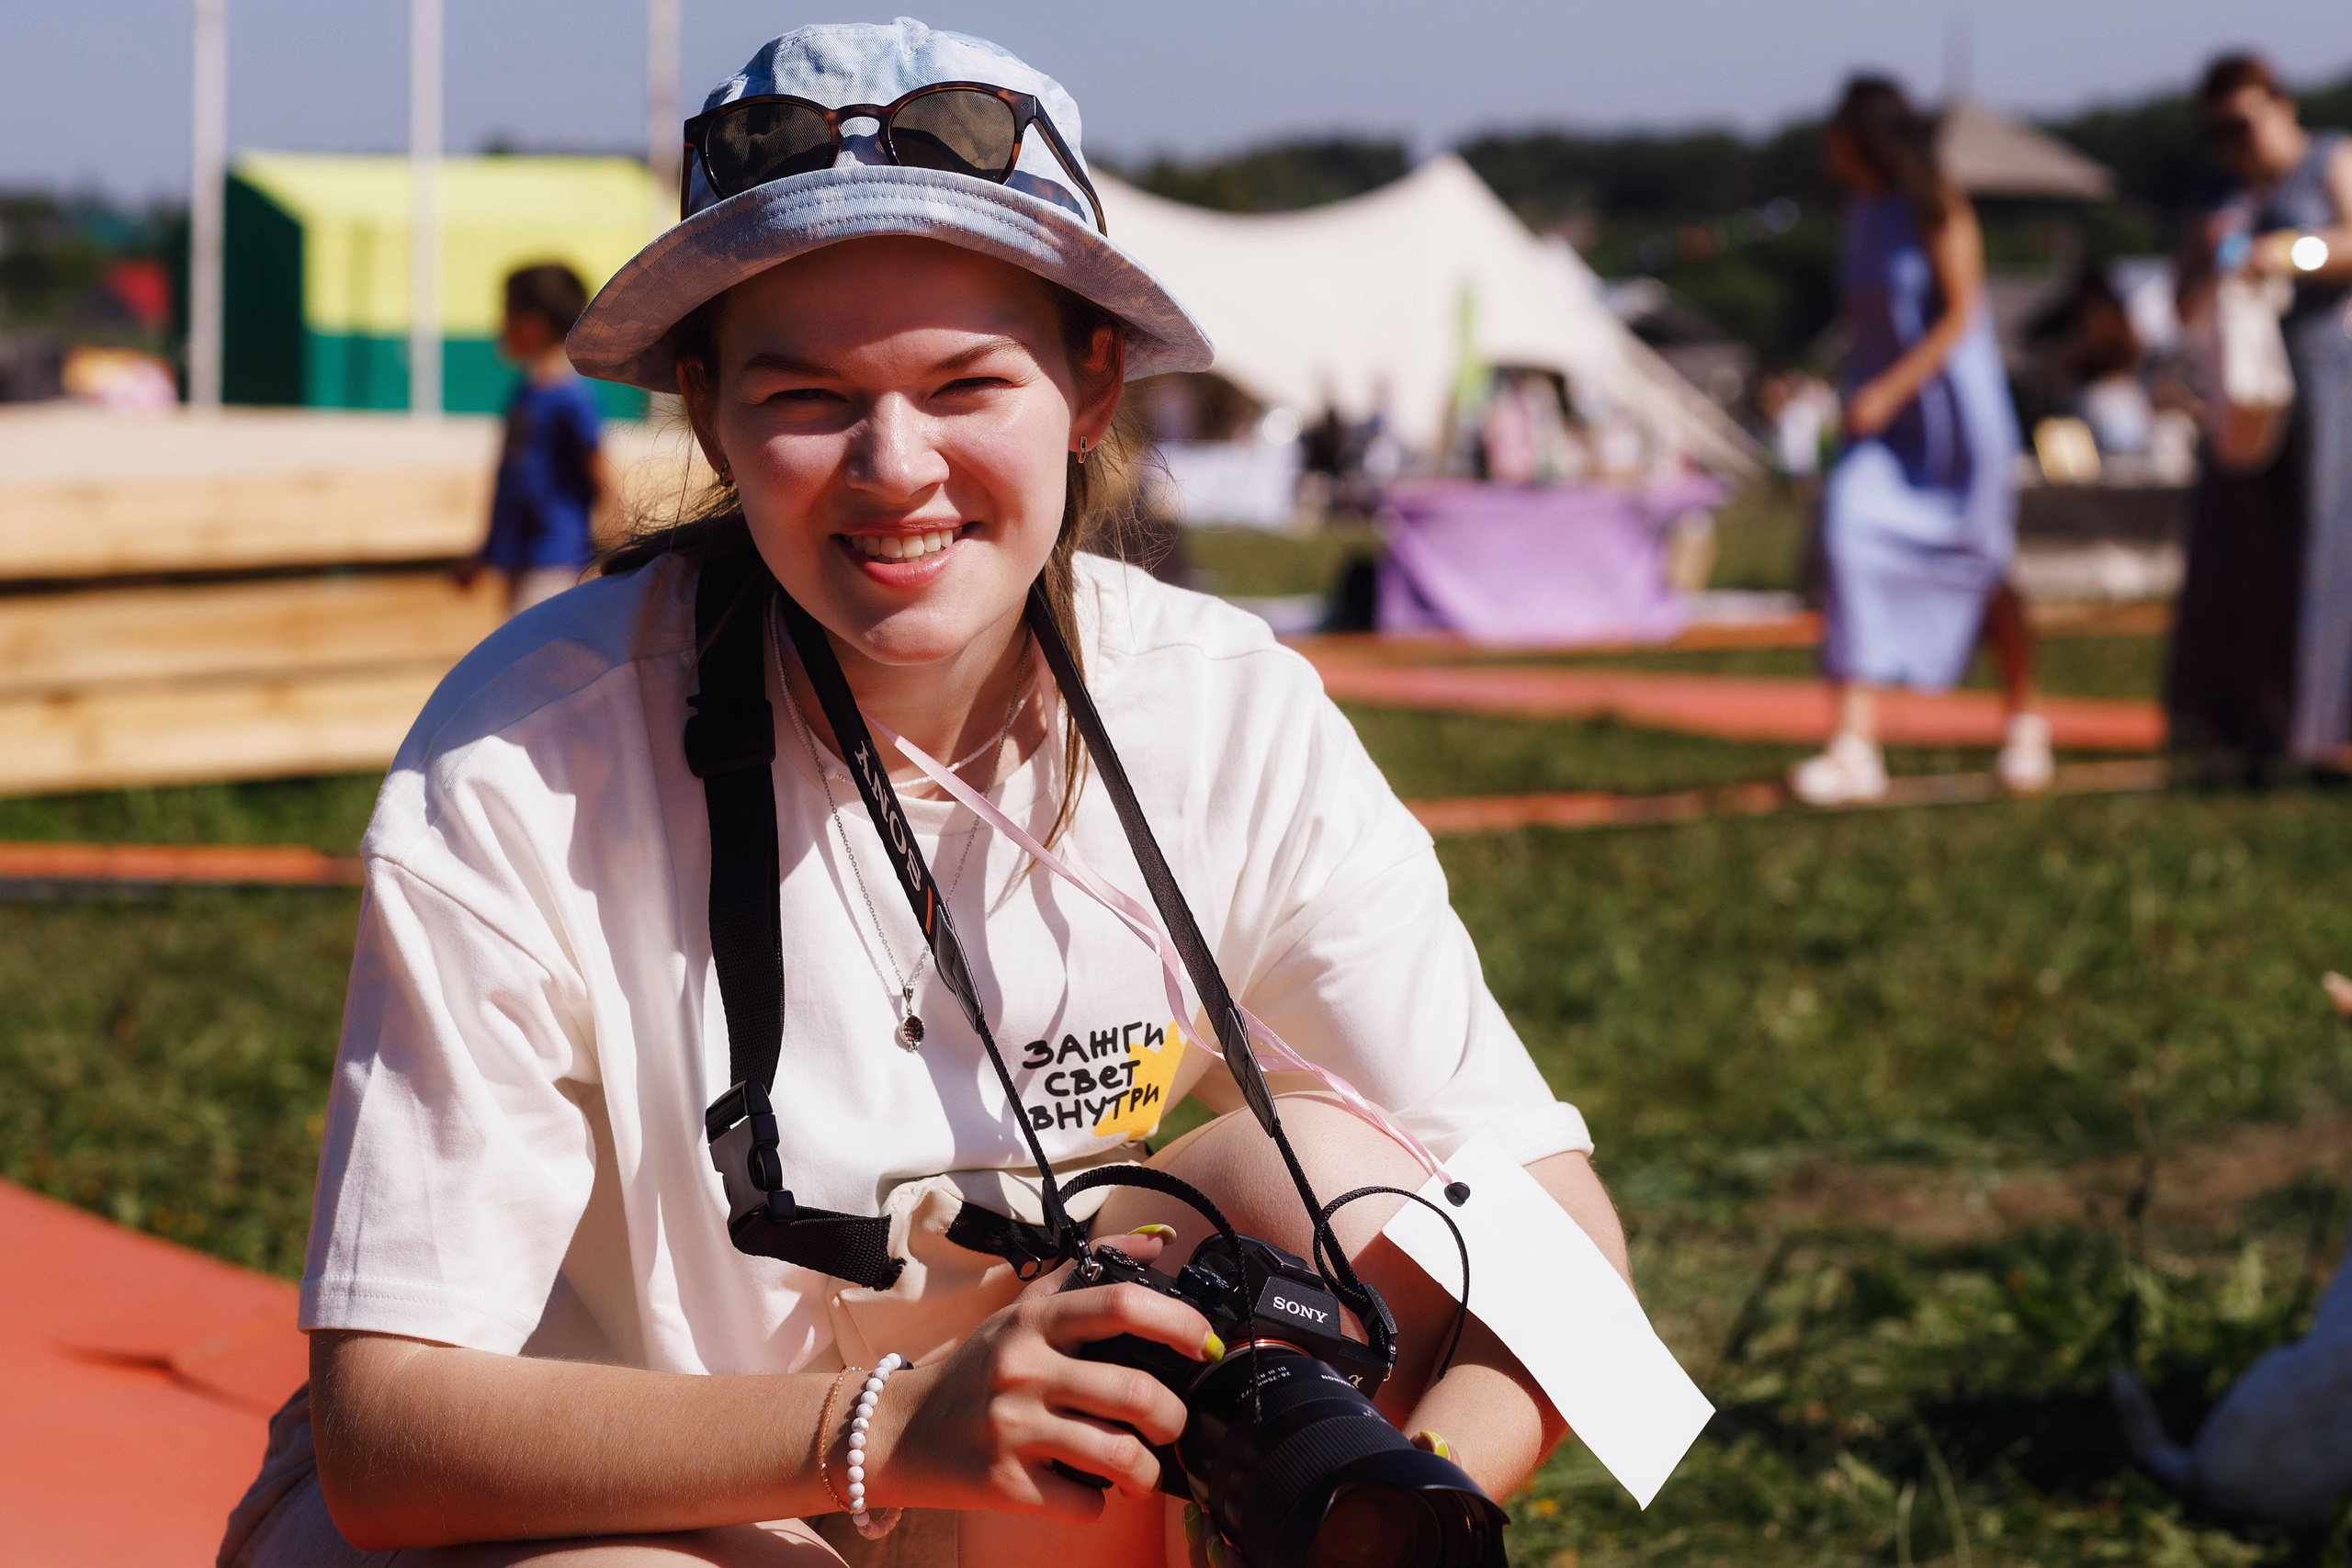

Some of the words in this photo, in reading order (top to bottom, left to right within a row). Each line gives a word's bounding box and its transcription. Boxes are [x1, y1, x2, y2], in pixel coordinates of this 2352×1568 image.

[974, 92, 998, 104] Polaroid
[854, 740, 922, 892] SONY
[1023, 1021, 1164, 1069] ЗАЖГИ
[1028, 1083, 1159, 1131] ВНУТРИ
[1272, 1296, 1329, 1324] SONY
